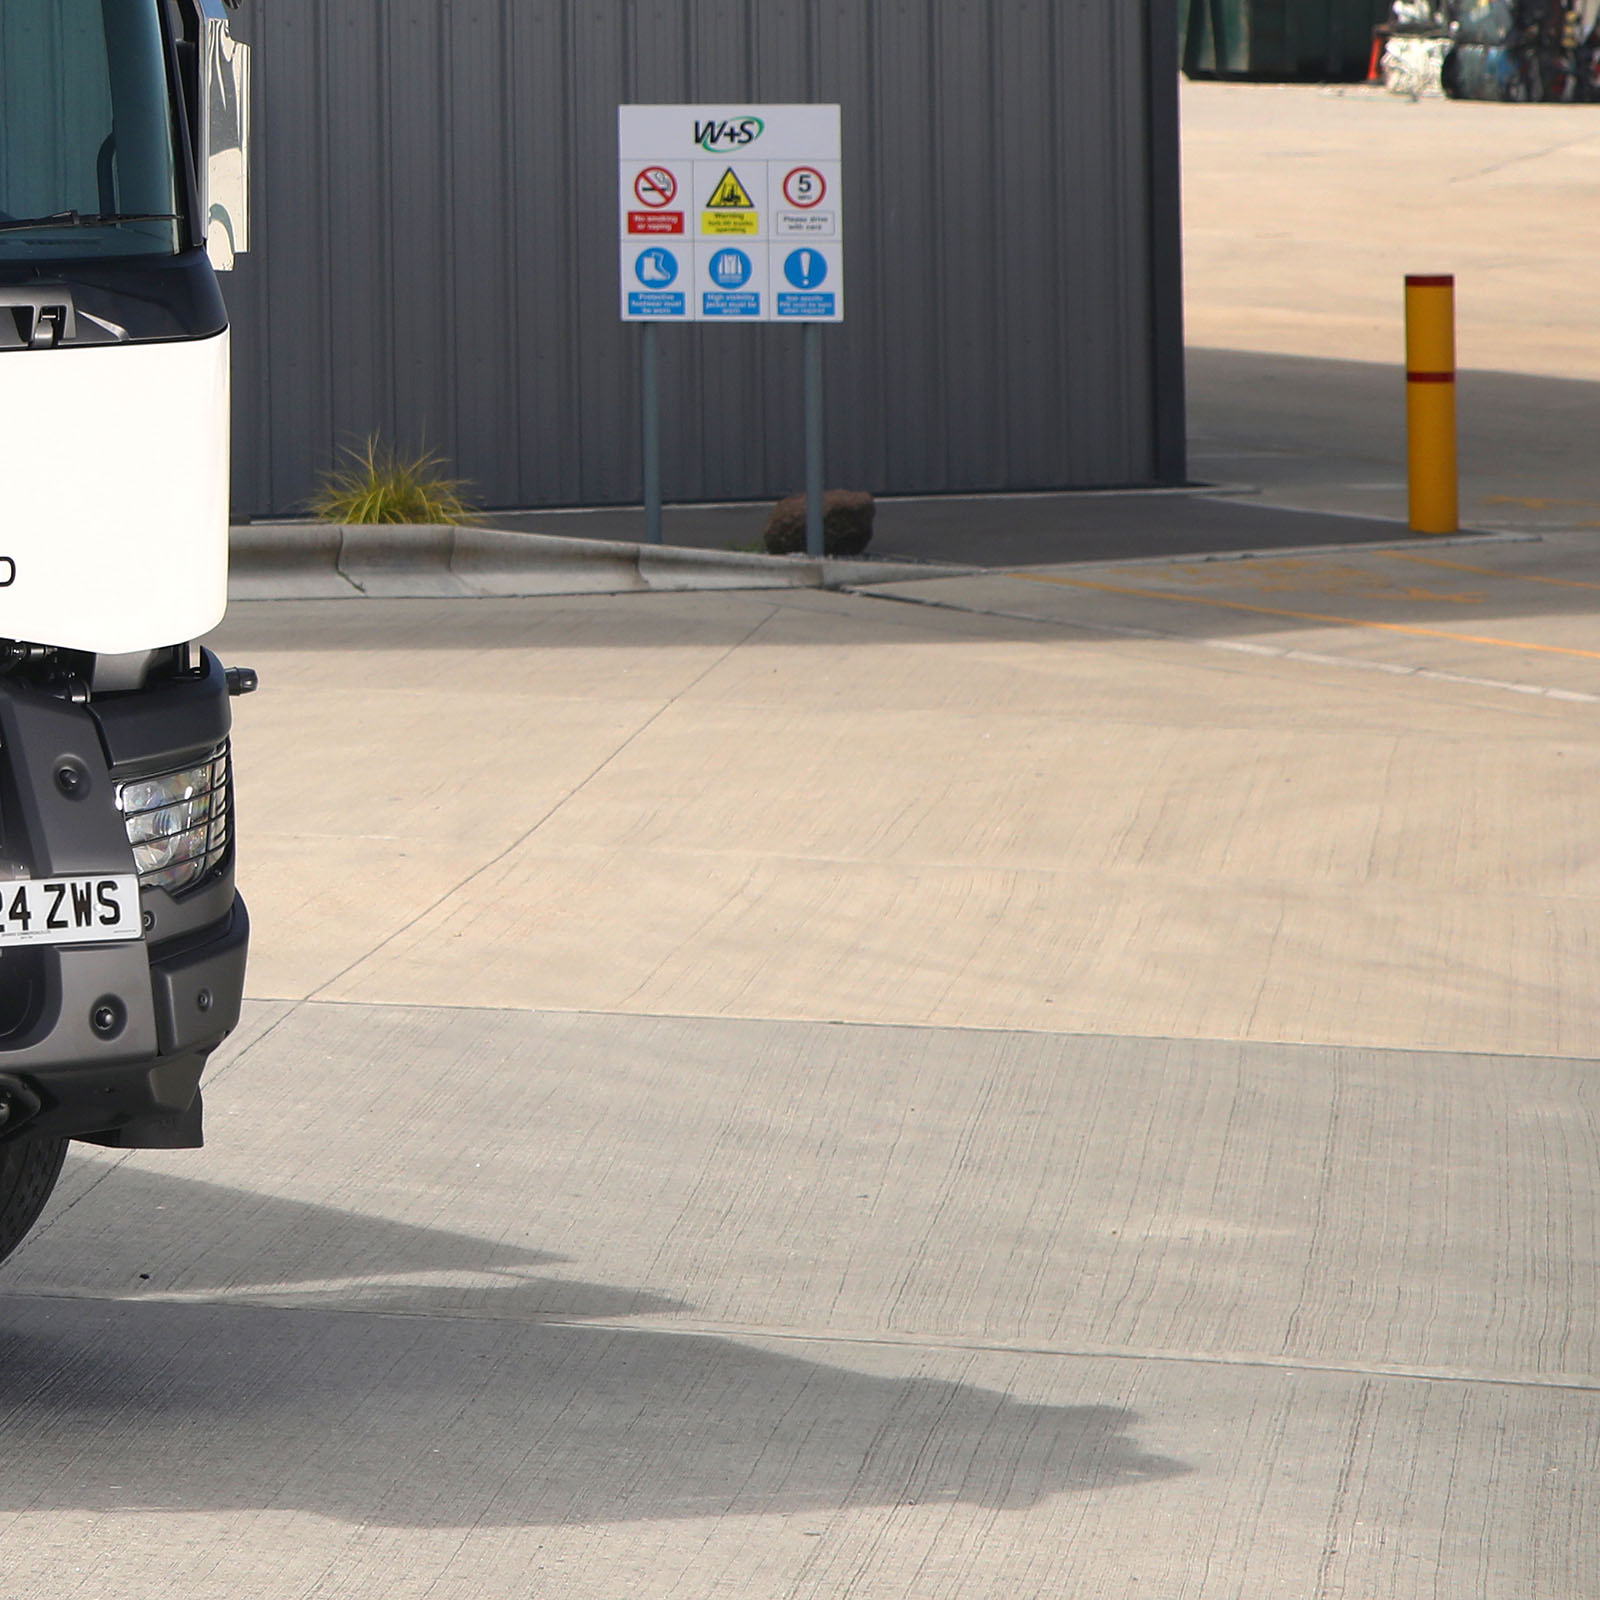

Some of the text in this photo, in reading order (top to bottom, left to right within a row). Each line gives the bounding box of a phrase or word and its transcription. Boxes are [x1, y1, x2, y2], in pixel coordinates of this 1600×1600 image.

[694, 120, 755, 145] W+S
[799, 174, 812, 193] 5
[43, 880, 121, 929] ZWS
